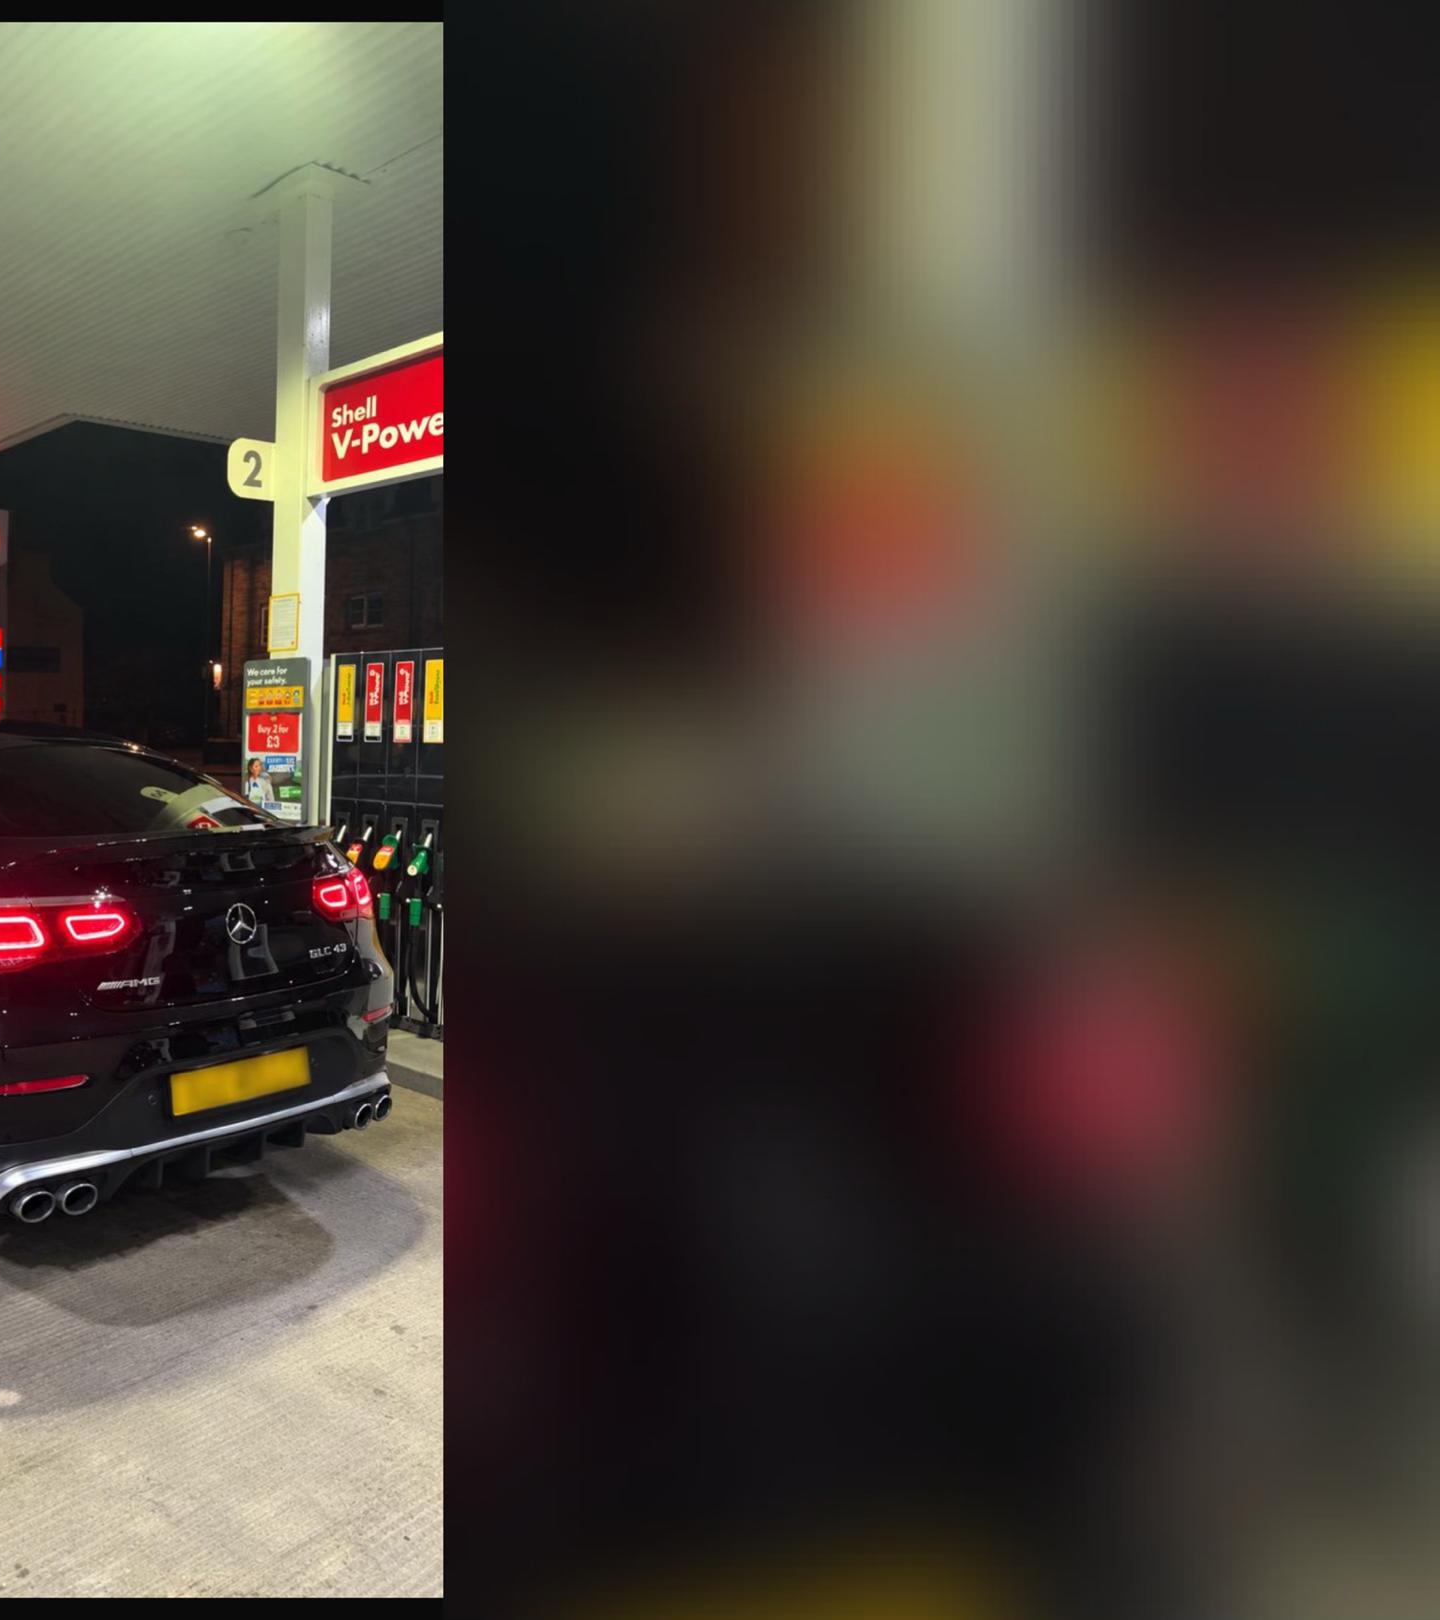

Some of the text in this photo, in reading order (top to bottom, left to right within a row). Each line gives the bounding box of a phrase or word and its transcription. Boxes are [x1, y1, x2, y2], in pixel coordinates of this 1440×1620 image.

[331, 395, 377, 428] Shell
[243, 450, 263, 488] 2
[247, 668, 259, 677] We
[276, 666, 288, 675] for
[257, 724, 289, 735] Buy 2 for
[266, 735, 280, 749] £3
[309, 943, 348, 959] GLC 43
[120, 976, 160, 988] AMG
